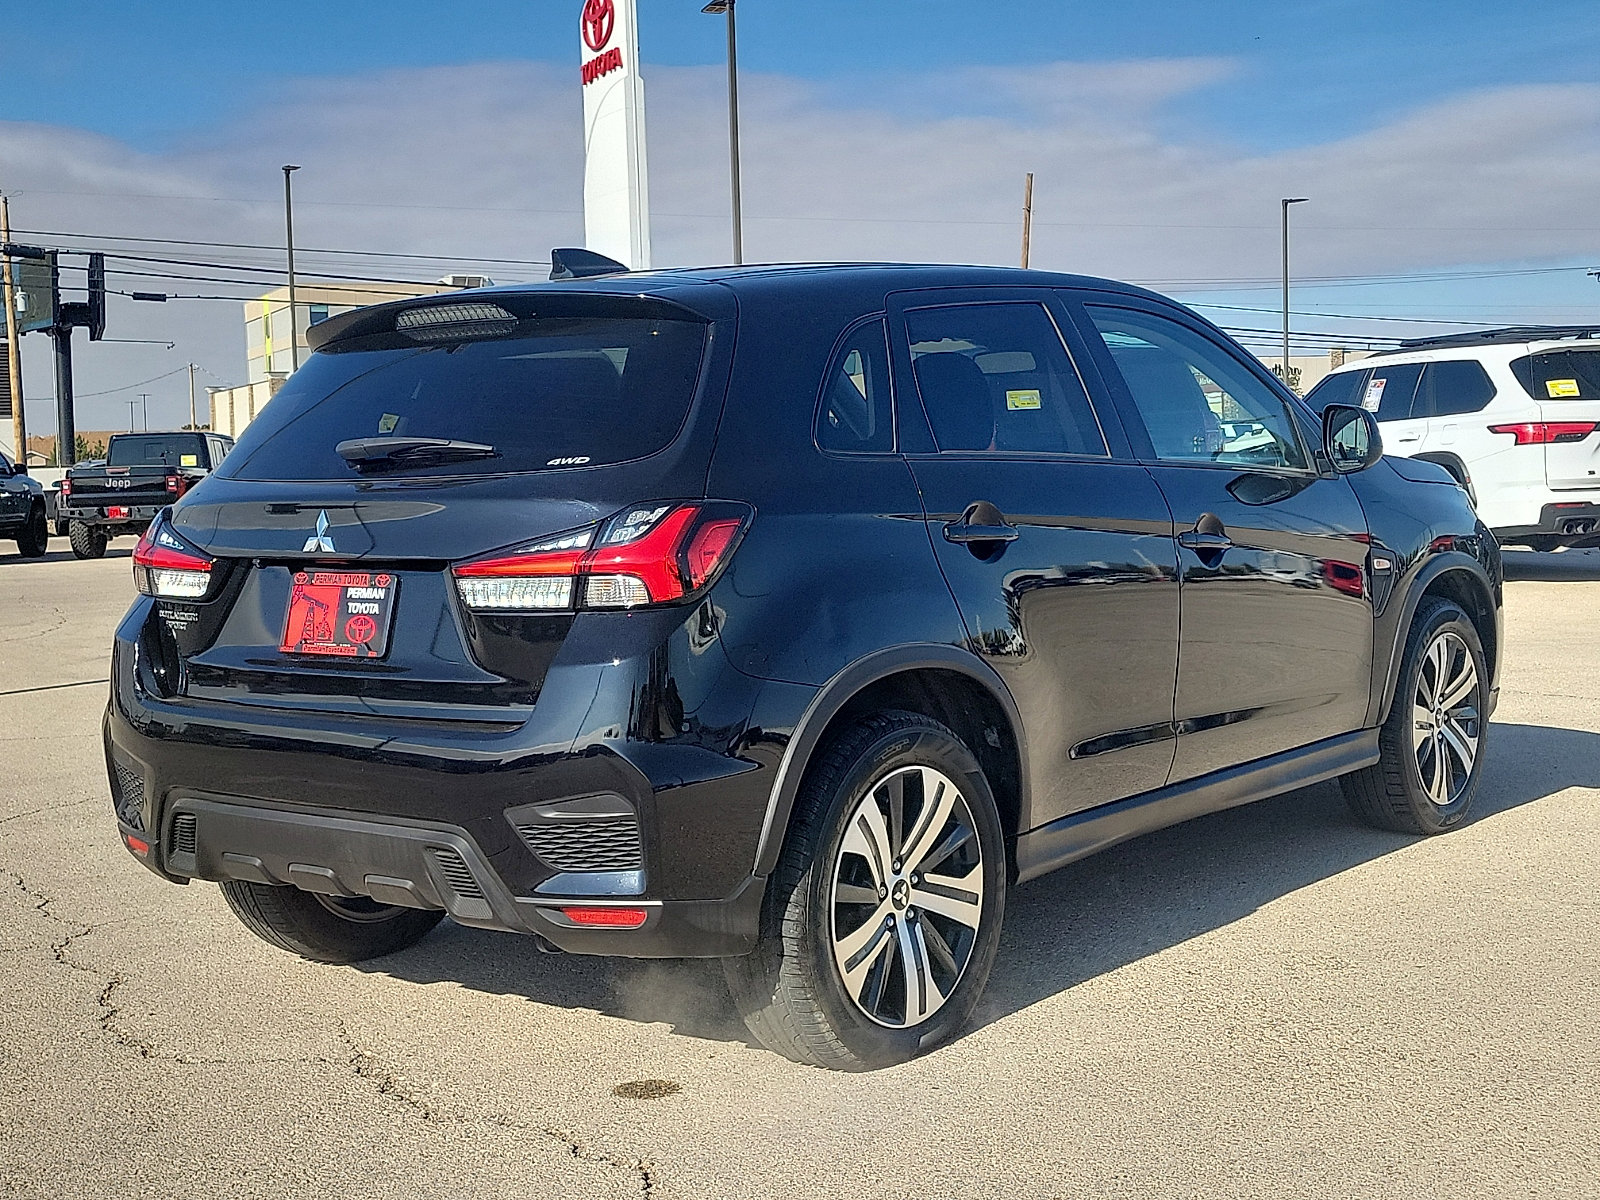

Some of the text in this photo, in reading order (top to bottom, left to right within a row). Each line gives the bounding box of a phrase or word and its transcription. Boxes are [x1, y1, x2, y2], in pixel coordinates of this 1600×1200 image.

[580, 47, 623, 86] TOYOTA
[546, 456, 591, 466] 4WD
[105, 478, 131, 487] Jeep
[314, 574, 367, 586] PERMIAN TOYOTA
[347, 587, 385, 599] PERMIAN
[347, 602, 379, 614] TOYOTA
